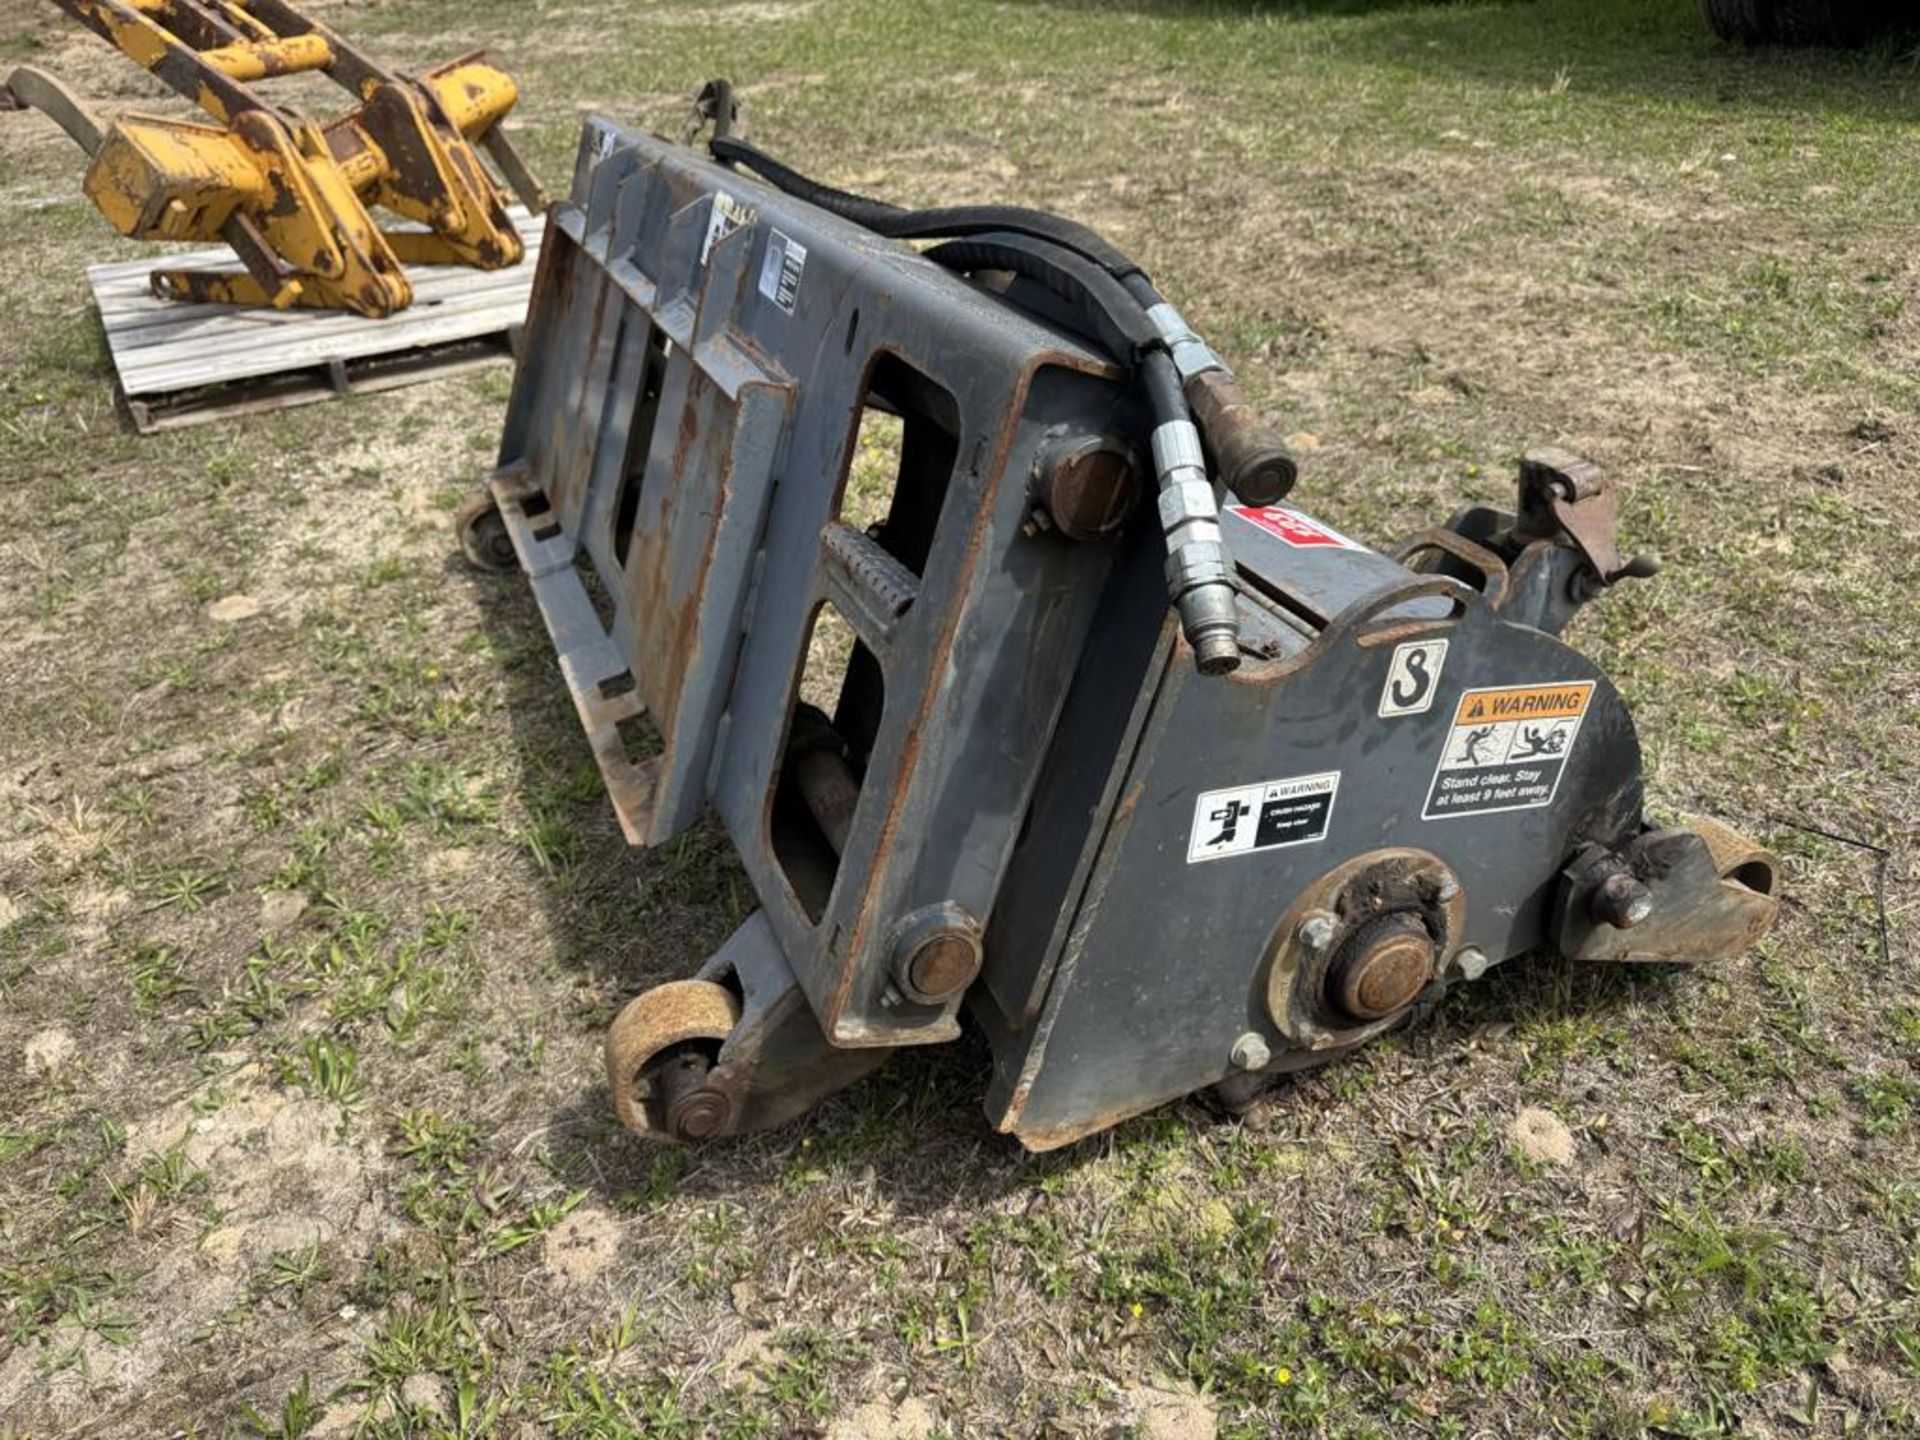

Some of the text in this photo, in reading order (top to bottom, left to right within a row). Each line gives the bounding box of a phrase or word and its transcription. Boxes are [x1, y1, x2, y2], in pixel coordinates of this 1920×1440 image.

[1492, 692, 1581, 715] WARNING
[1280, 779, 1331, 796] WARNING
[1441, 770, 1542, 790] Stand clear. Stay
[1435, 794, 1450, 806] at
[1451, 791, 1481, 804] least
[1482, 788, 1493, 800] 9
[1494, 787, 1517, 800] feet
[1518, 784, 1550, 797] away.
